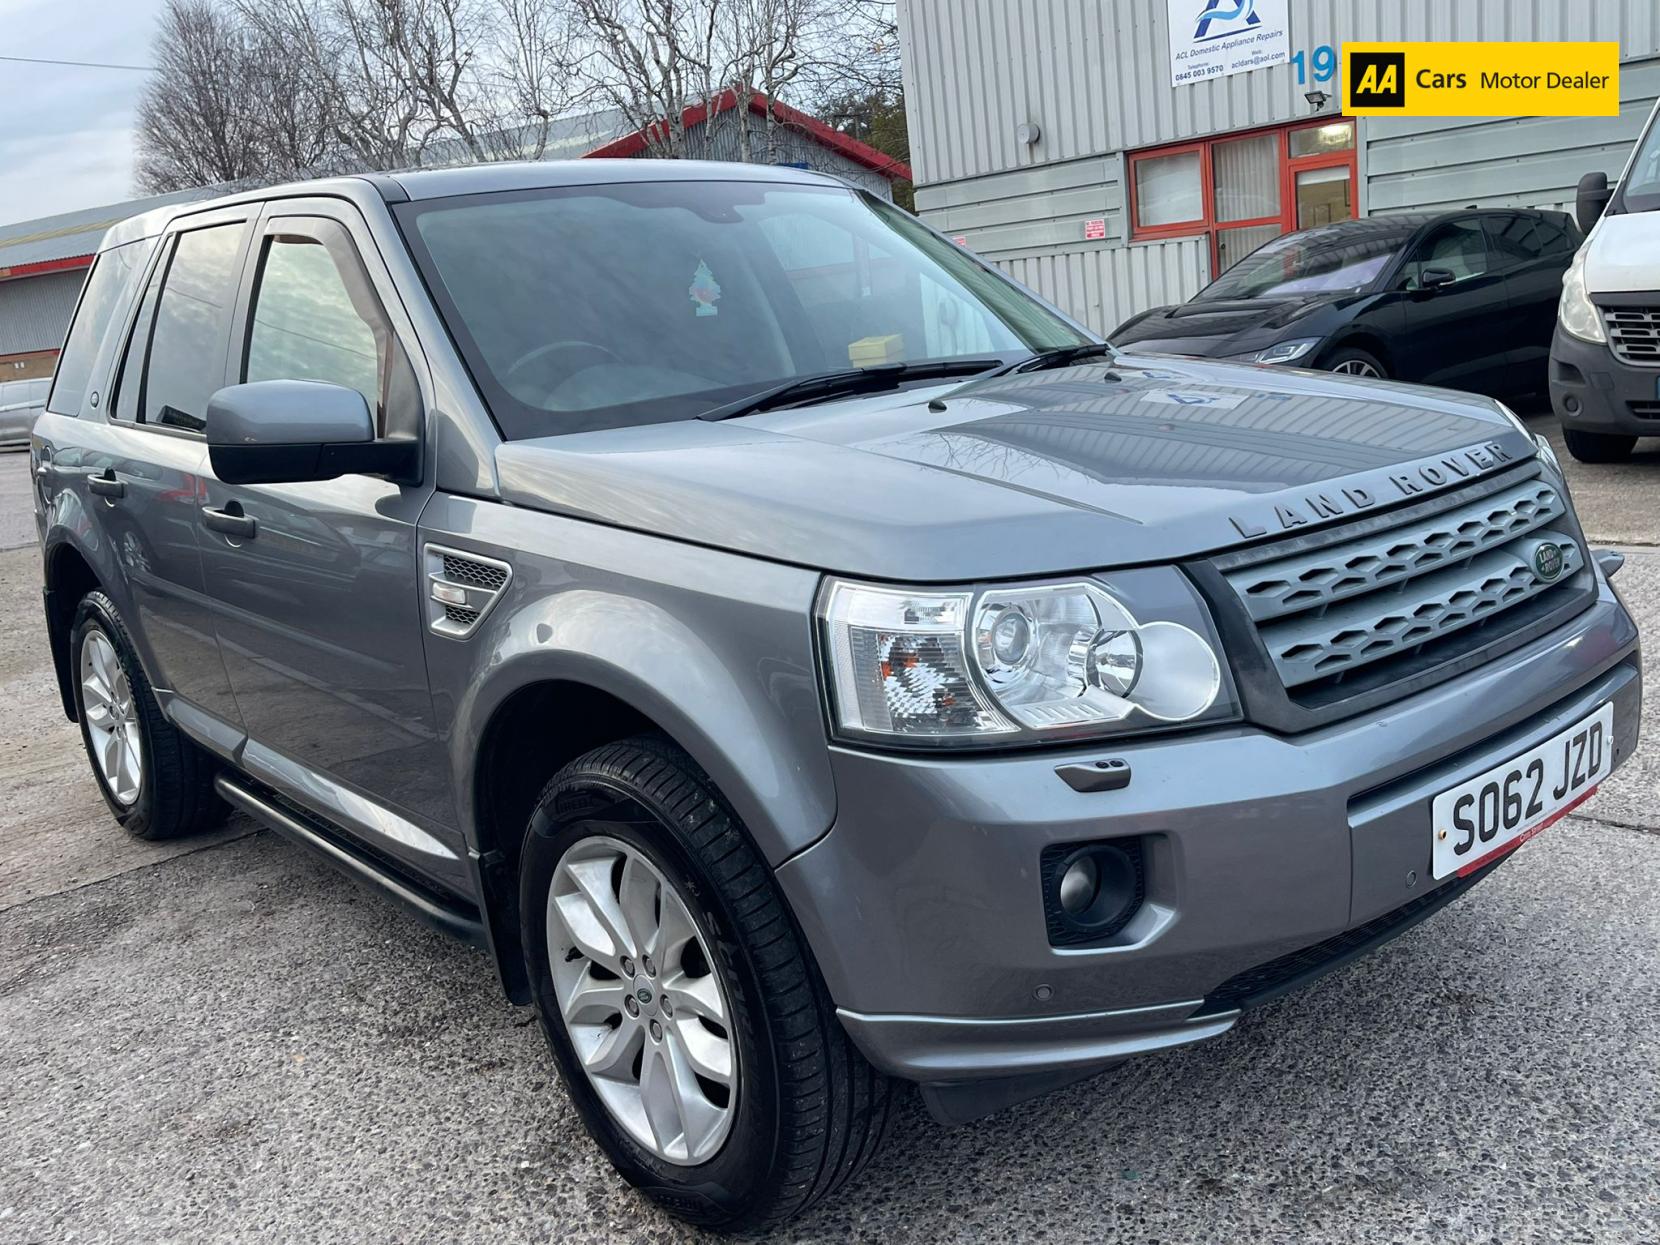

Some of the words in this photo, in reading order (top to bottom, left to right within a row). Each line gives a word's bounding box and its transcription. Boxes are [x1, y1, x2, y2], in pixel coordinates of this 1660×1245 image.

[1175, 51, 1189, 61] ACL
[1190, 44, 1221, 57] Domestic
[1221, 36, 1255, 51] Appliance
[1256, 30, 1283, 42] Repairs
[1291, 45, 1336, 85] 19
[1175, 71, 1191, 81] 0845
[1192, 68, 1206, 78] 003
[1207, 64, 1224, 74] 9570
[1228, 487, 1376, 538] LAND
[1389, 442, 1513, 495] ROVER
[1453, 758, 1544, 856] SO62
[1553, 720, 1603, 801] JZD
